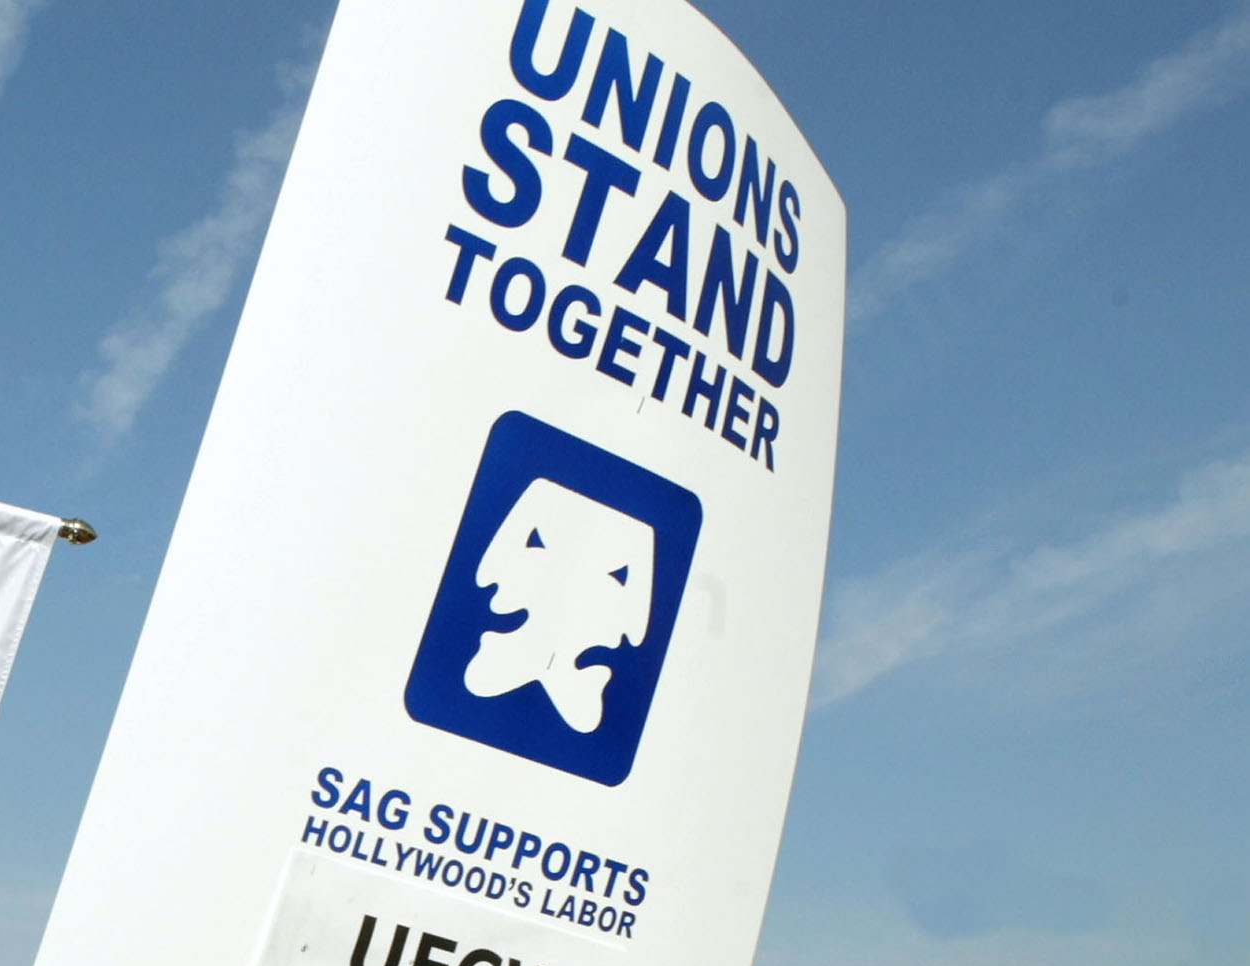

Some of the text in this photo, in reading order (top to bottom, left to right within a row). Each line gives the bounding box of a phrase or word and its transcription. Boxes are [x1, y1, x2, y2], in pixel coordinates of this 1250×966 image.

[463, 99, 794, 388] STAND
[510, 0, 800, 274] UNIONS
[444, 224, 779, 472] TOGETHER
[301, 816, 636, 939] HOLLYWOOD'S LABOR
[311, 767, 649, 906] SAG SUPPORTS
